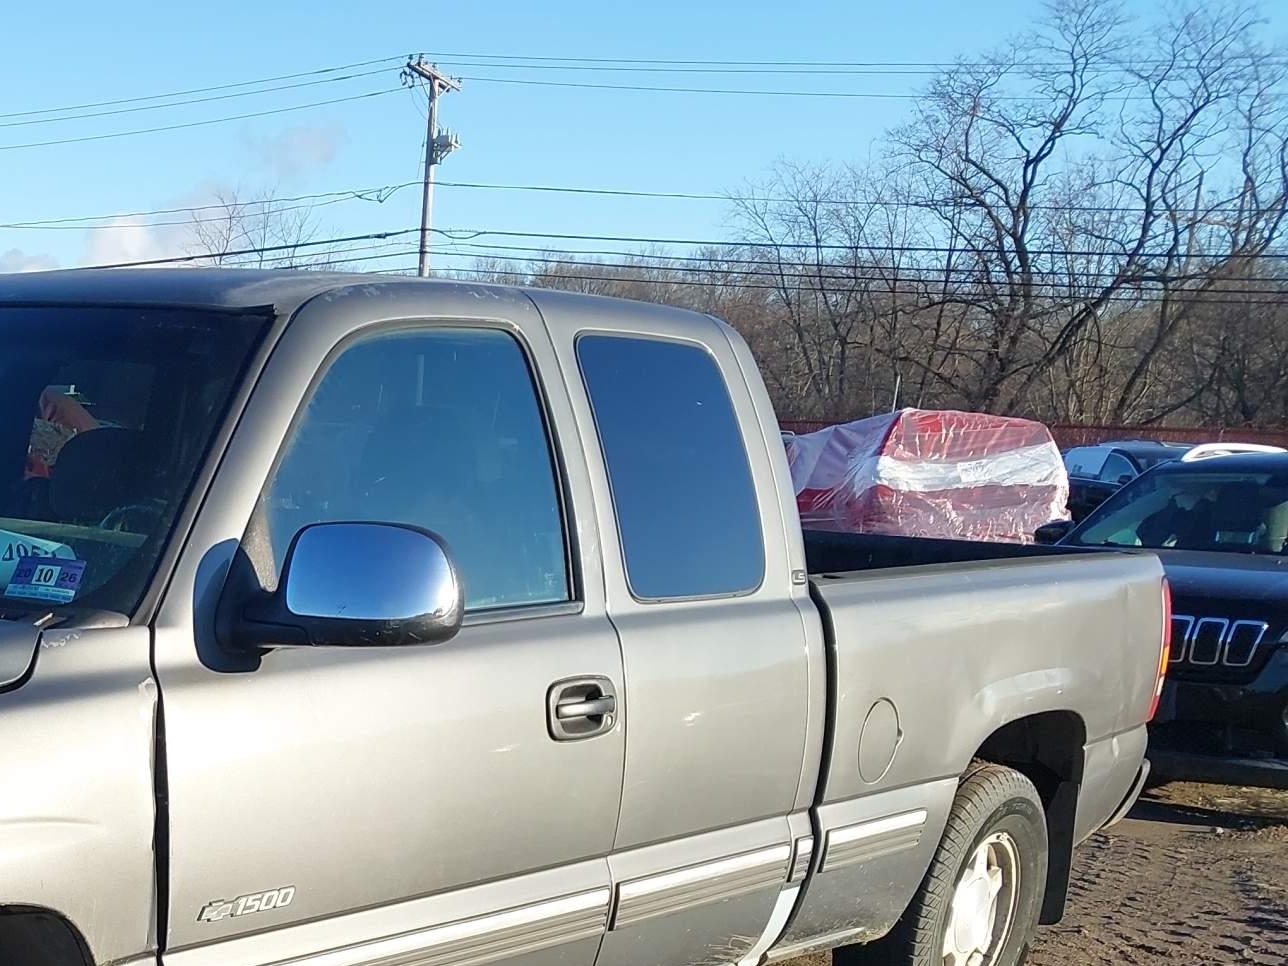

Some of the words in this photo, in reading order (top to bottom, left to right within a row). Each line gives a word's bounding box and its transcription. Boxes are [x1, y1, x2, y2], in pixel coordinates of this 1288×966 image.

[35, 568, 54, 584] 10
[60, 571, 78, 583] 26
[792, 572, 806, 584] LS
[235, 886, 295, 915] 1500
